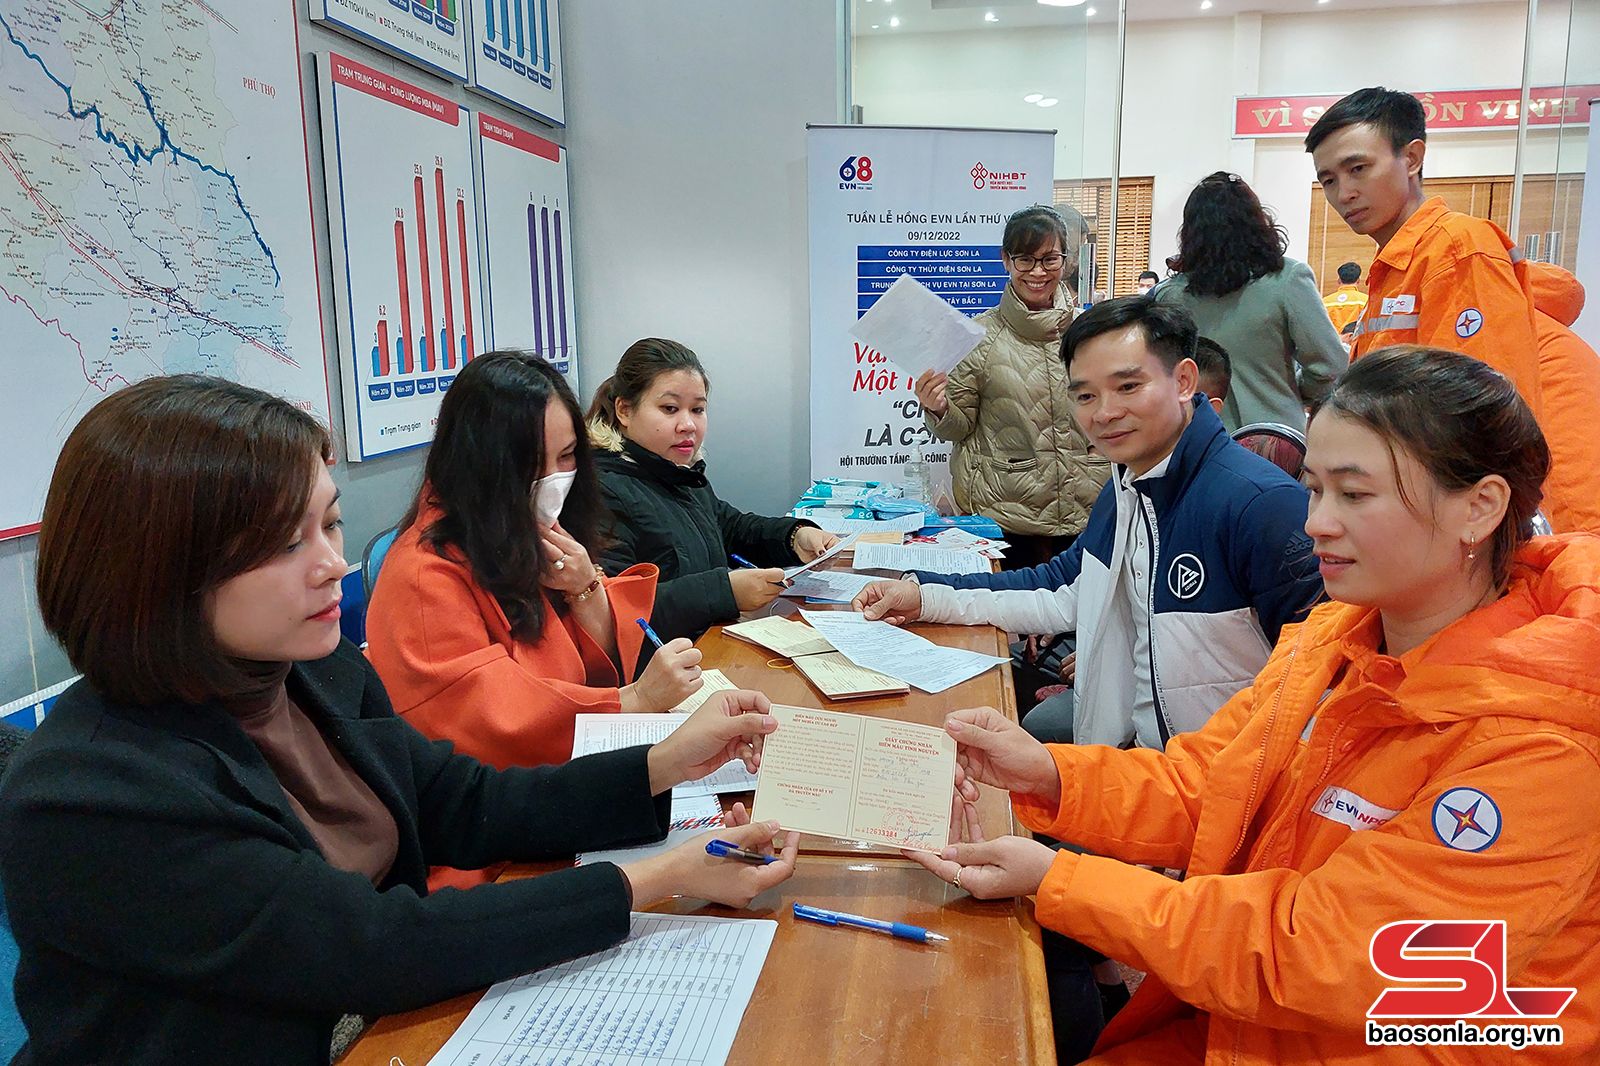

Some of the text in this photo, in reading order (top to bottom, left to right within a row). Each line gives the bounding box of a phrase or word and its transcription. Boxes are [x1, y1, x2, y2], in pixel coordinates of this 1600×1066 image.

[337, 64, 354, 80] TRẠM
[354, 71, 372, 86] TRUNG
[373, 78, 386, 91] GIAN
[242, 77, 276, 98] PHÚ THỌ
[1252, 100, 1292, 128] VÌ
[1302, 106, 1326, 126] S
[1477, 96, 1580, 120] VINH
[840, 156, 872, 181] 68
[847, 211, 875, 224] TUẦN
[879, 209, 893, 223] LỄ
[896, 211, 927, 224] HỒNG
[931, 214, 952, 224] EVN
[956, 211, 976, 224] LẦN
[980, 212, 1000, 224] THỨ
[907, 231, 961, 241] 09/12/2022
[888, 249, 908, 257] CÔNG
[921, 249, 938, 258] ĐIỆN
[939, 249, 953, 258] LỰC
[955, 249, 969, 257] SƠN
[885, 265, 906, 273] CÔNG
[939, 266, 953, 274] ĐIỆN
[954, 265, 969, 273] SƠN
[932, 281, 942, 289] VỤ
[959, 281, 970, 289] TẠI
[961, 295, 977, 304] BẮC
[853, 369, 898, 395] Một
[864, 424, 892, 446] LÀ
[840, 455, 853, 468] HỘI
[856, 454, 887, 465] TRƯỜNG
[925, 452, 947, 463] CÔNG
